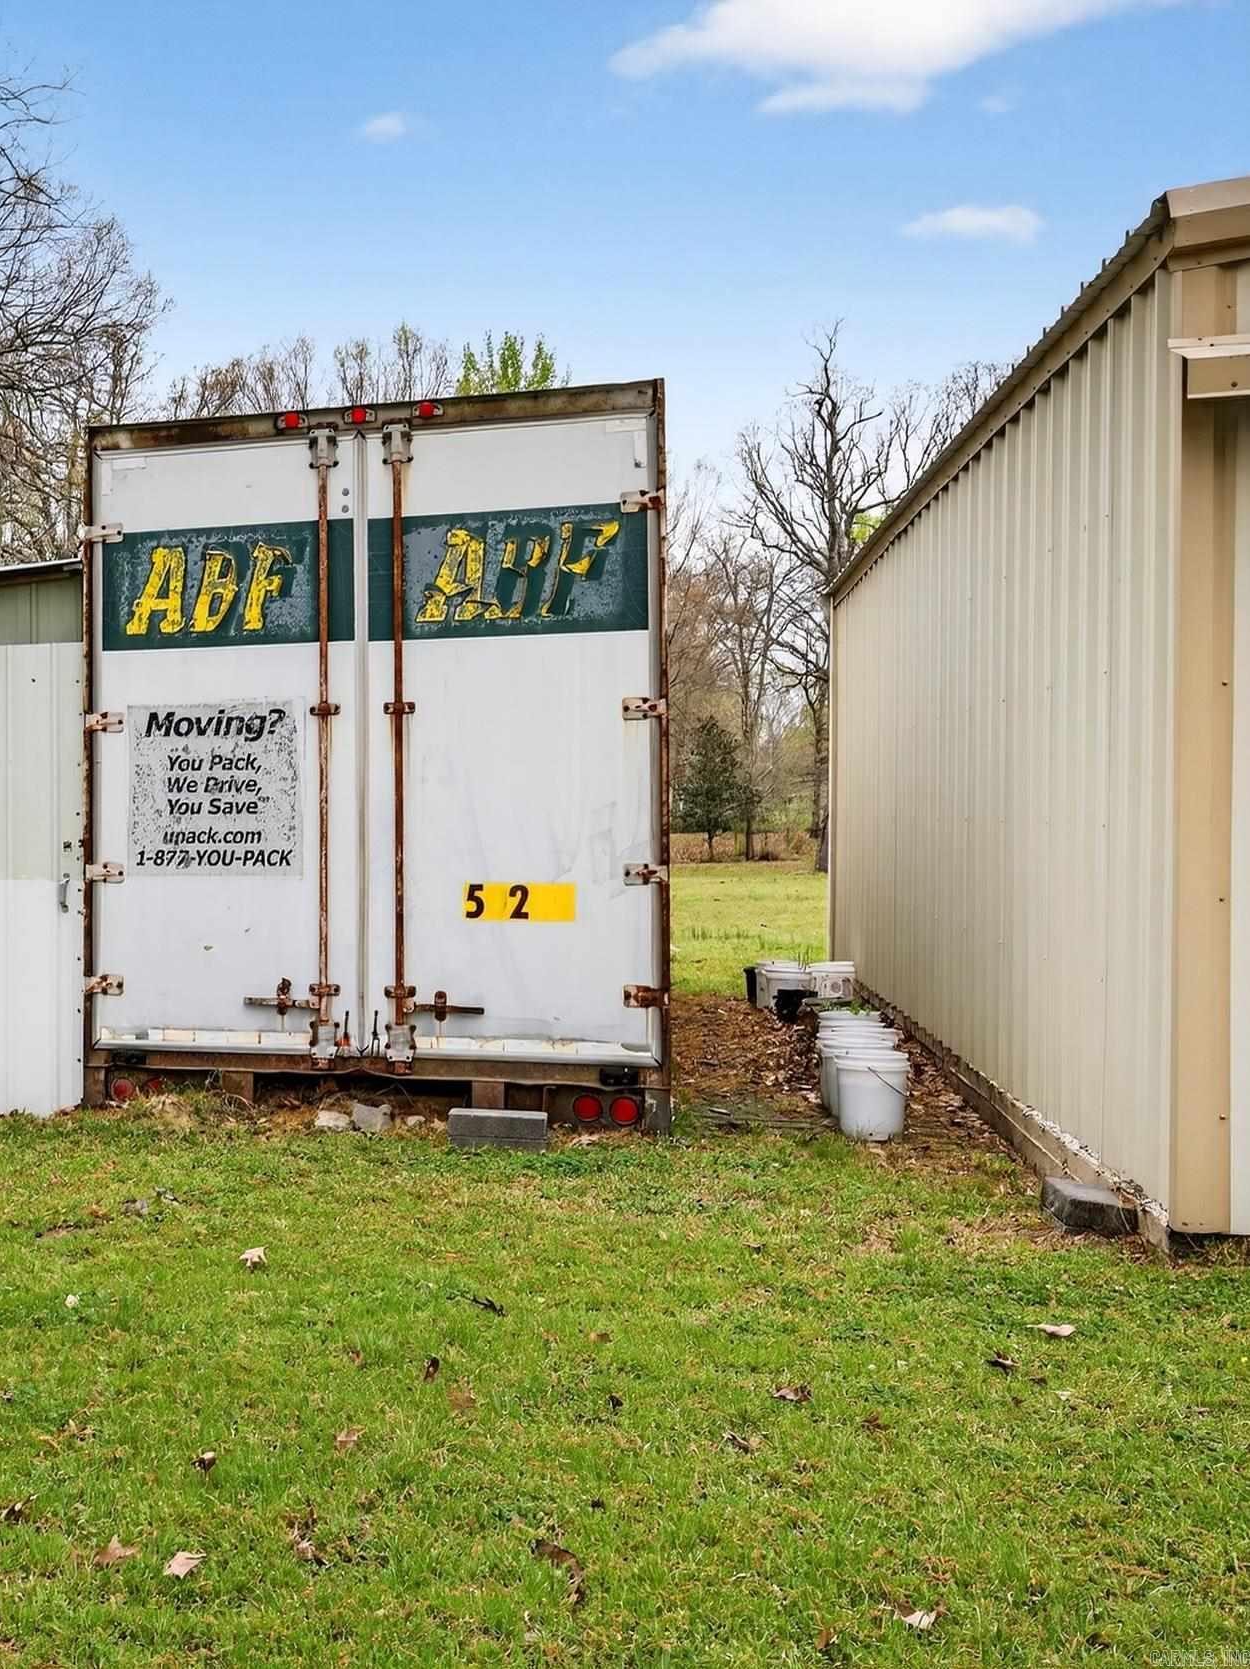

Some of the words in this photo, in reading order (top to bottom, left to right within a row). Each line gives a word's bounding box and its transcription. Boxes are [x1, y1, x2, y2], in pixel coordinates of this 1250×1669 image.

[125, 541, 293, 636] ABF
[145, 708, 286, 742] Moving?
[167, 755, 204, 772] You
[208, 753, 262, 774] Pack,
[167, 776, 198, 793] We
[204, 775, 262, 796] Drive,
[167, 798, 203, 815] You
[207, 798, 259, 815] Save
[162, 826, 262, 845] upack.com
[136, 849, 293, 867] 1-877-YOU-PACK
